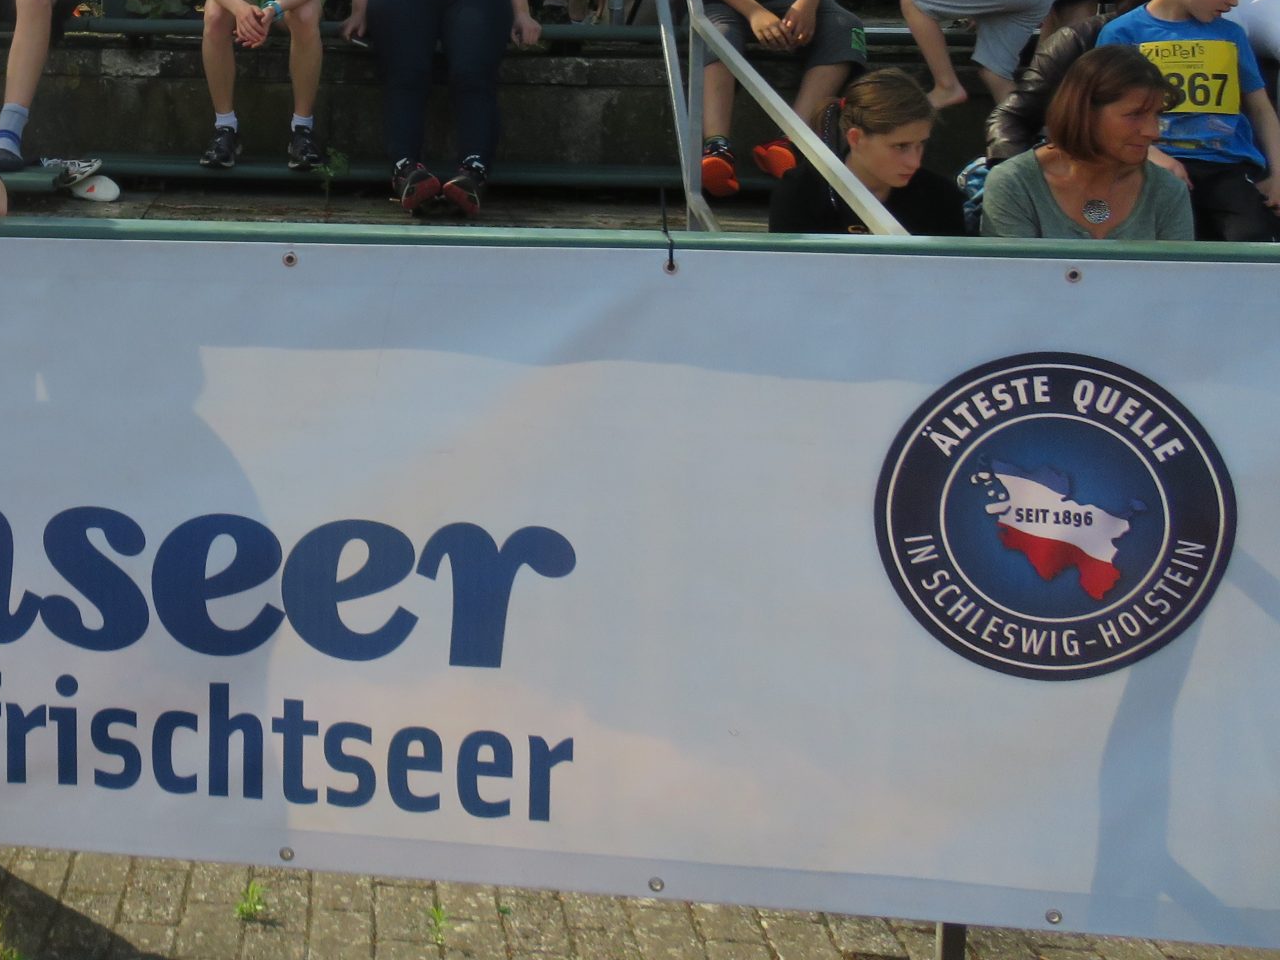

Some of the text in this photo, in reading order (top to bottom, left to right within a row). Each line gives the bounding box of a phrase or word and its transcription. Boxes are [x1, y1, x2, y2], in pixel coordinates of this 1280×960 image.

[921, 375, 1185, 463] ÄLTESTE QUELLE
[1014, 507, 1094, 528] SEIT 1896
[903, 534, 1207, 657] IN SCHLESWIG-HOLSTEIN
